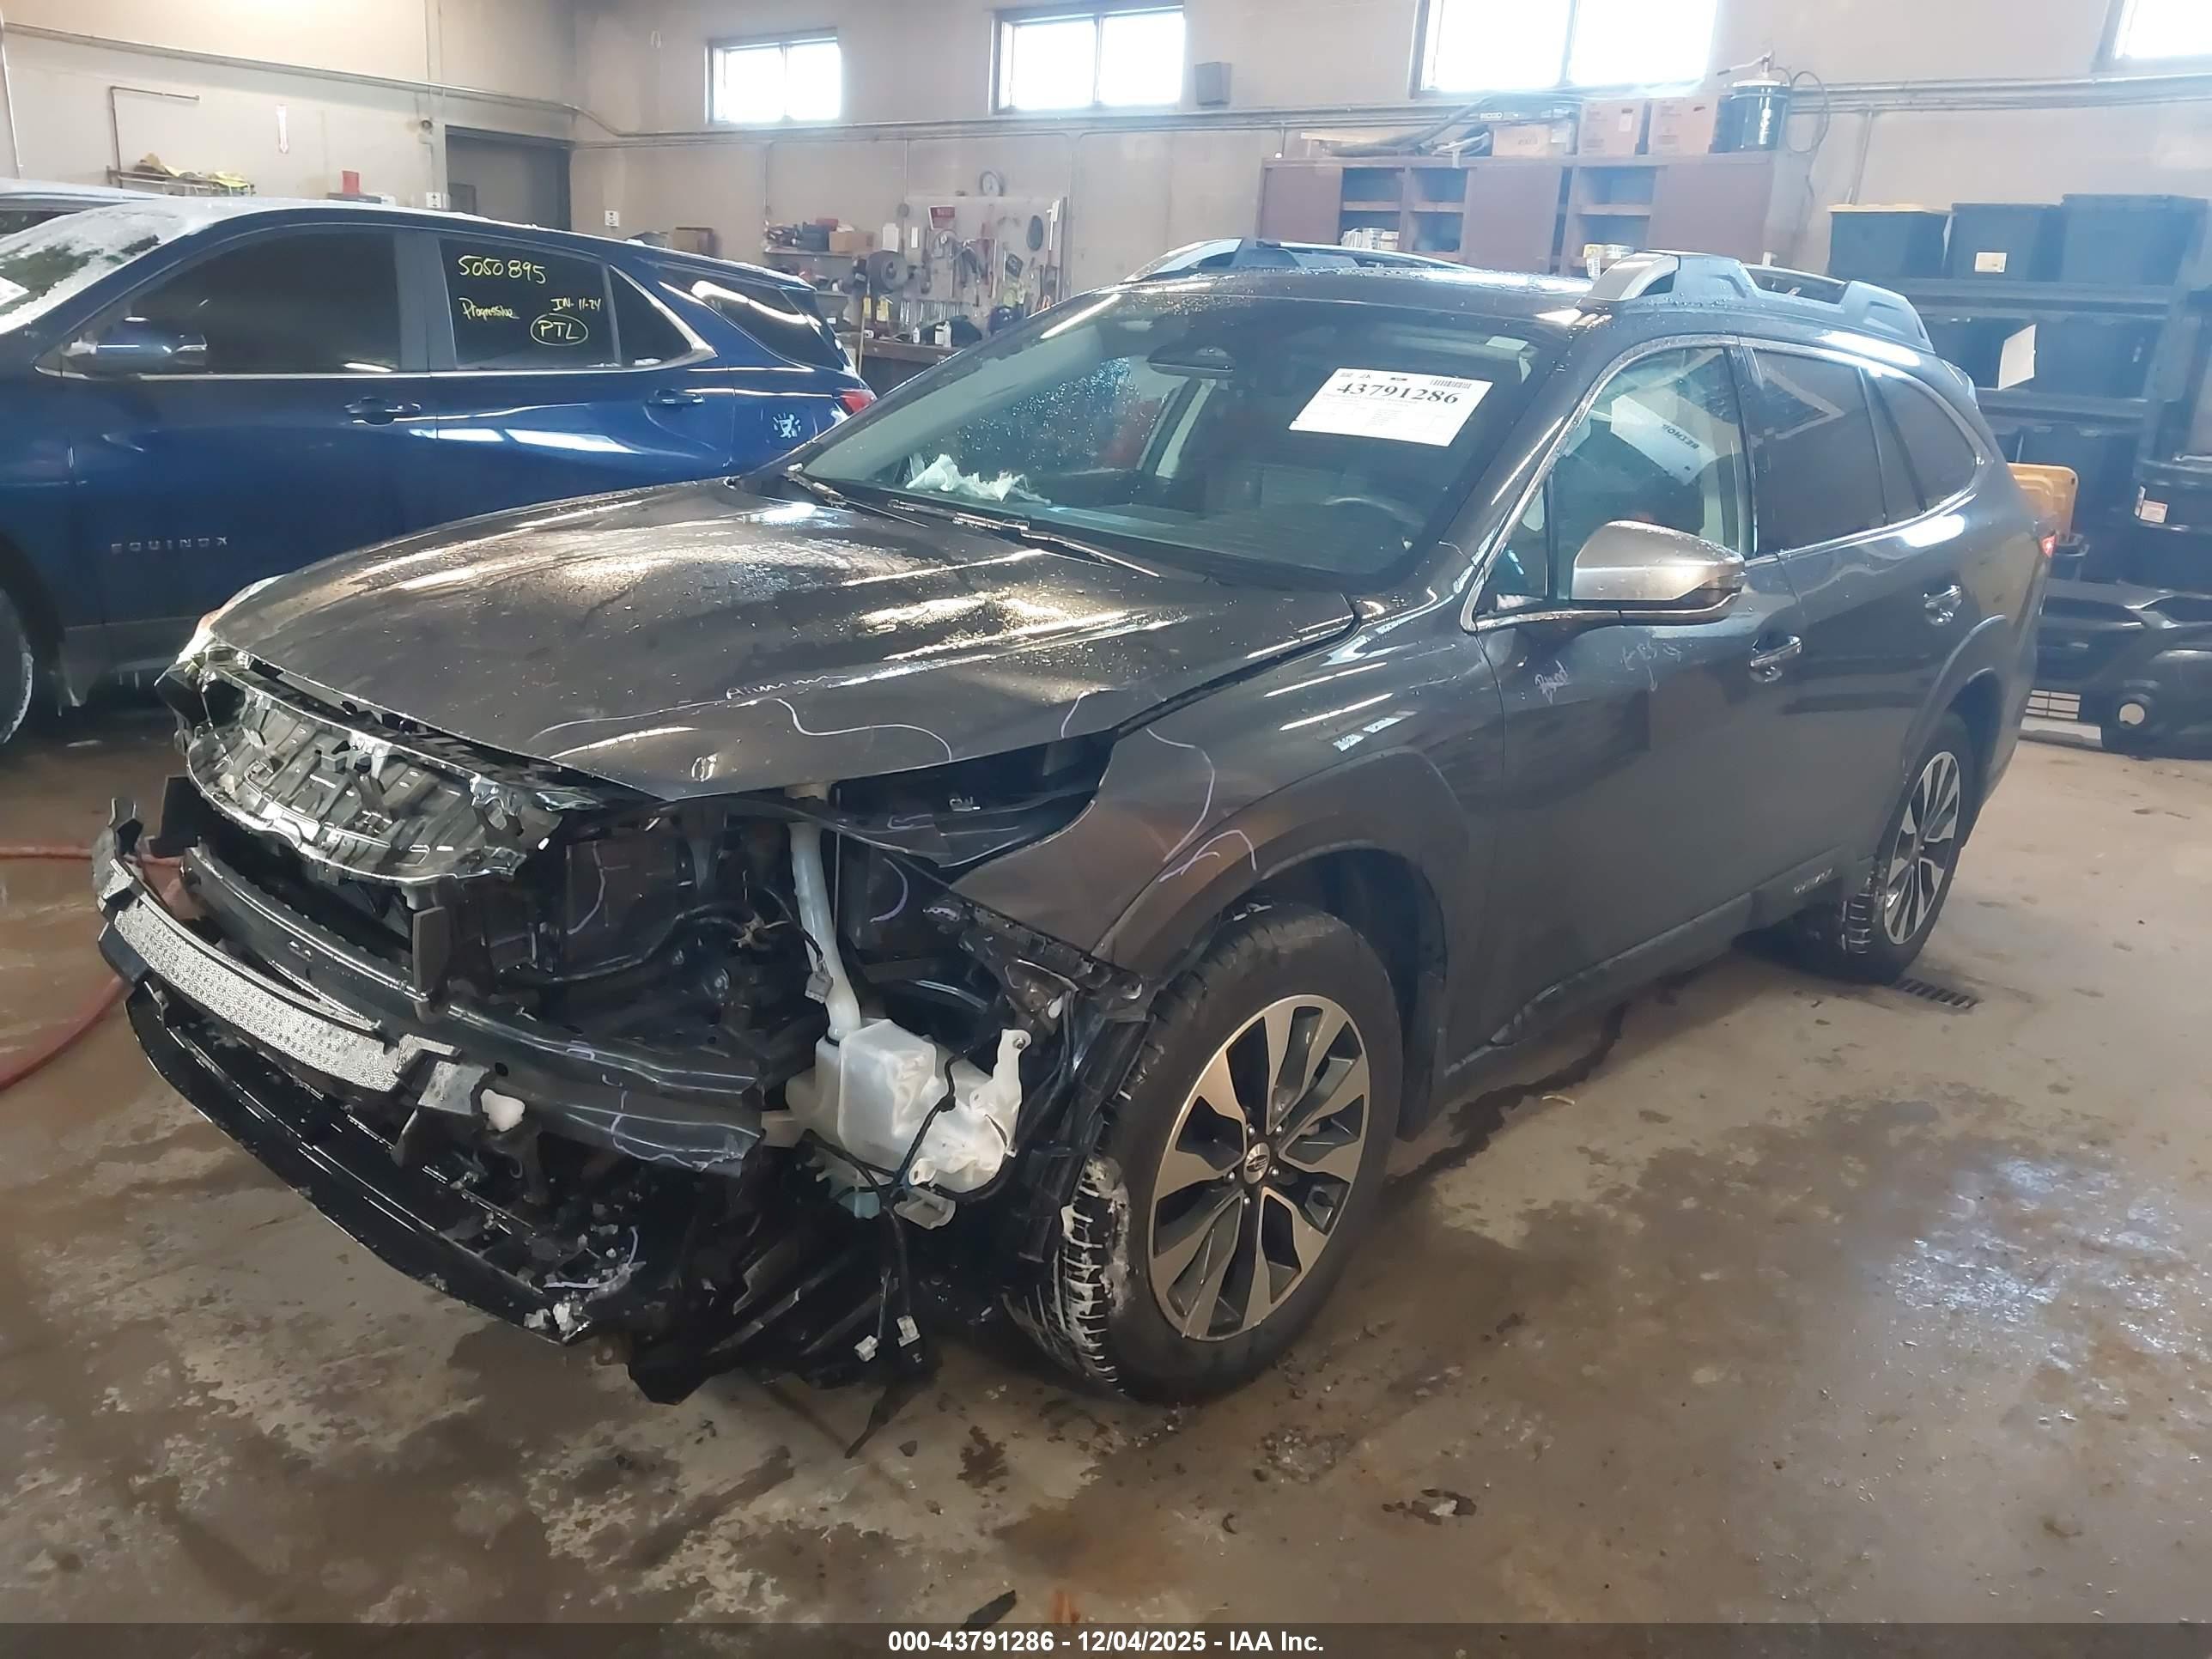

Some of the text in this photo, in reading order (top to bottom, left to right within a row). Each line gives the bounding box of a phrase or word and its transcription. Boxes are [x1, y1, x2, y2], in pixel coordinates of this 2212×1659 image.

[458, 254, 546, 284] 5050895
[537, 319, 580, 340] PTL
[1336, 382, 1462, 404] 43791286
[111, 536, 228, 554] EQUINOX
